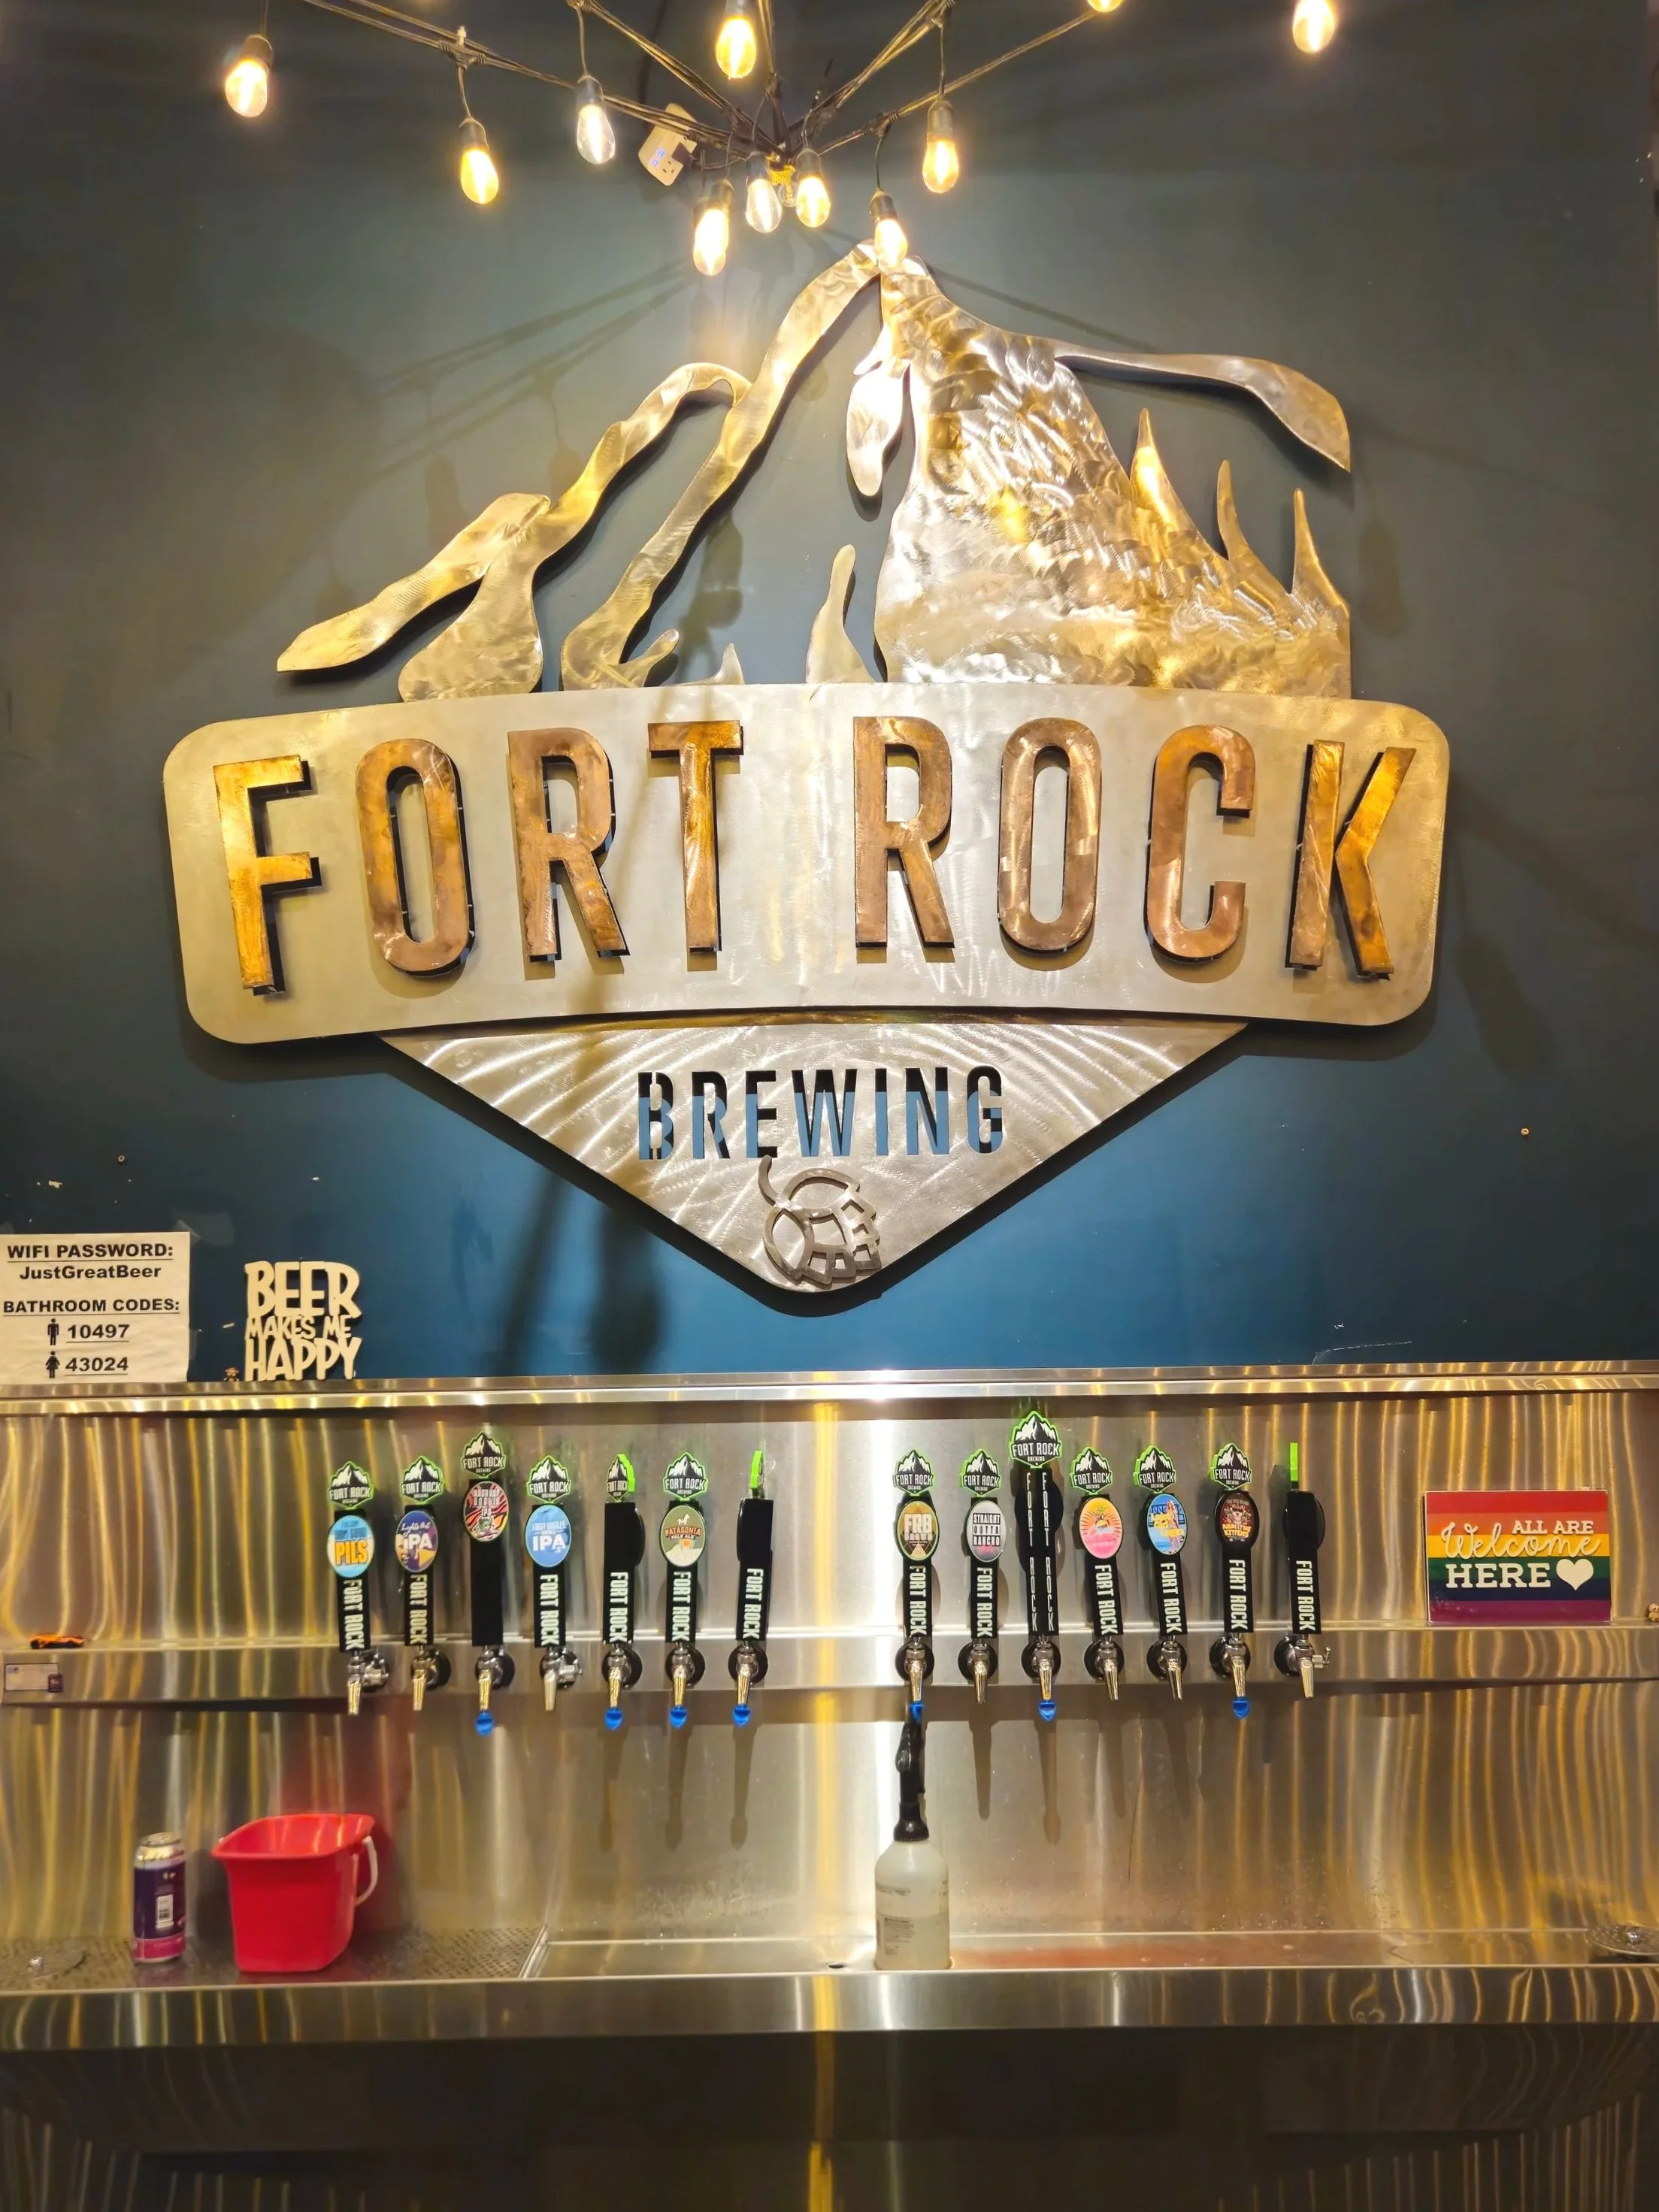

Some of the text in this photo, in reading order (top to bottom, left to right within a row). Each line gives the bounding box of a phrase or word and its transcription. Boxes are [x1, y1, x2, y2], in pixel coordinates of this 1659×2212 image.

[213, 716, 1417, 994] FORT ROCK
[638, 1065, 1003, 1159] BREWING
[8, 1244, 173, 1258] WIFI PASSWORD:
[20, 1265, 161, 1280] JustGreatBeer
[244, 1260, 362, 1318] BEER
[3, 1299, 180, 1313] BATHROOM CODES:
[66, 1324, 130, 1339] 10497
[246, 1315, 352, 1339] MAKES ME
[65, 1357, 129, 1372] 43024
[245, 1337, 362, 1381] HAPPY
[1013, 1442, 1059, 1457] FORT ROCK
[463, 1457, 503, 1469] FORT ROCK
[1215, 1469, 1250, 1481] FORT ROCK
[402, 1481, 441, 1494] FORT ROCK
[529, 1481, 569, 1493] FORT ROCK
[665, 1478, 705, 1490] FORT ROCK
[895, 1474, 932, 1485] FORT ROCK
[964, 1475, 999, 1487] FORT ROCK
[1073, 1473, 1111, 1485] FORT ROCK
[1139, 1472, 1174, 1484] FORT ROCK
[330, 1487, 371, 1500] FORT ROCK
[973, 1514, 1001, 1524] STRAIGHT
[973, 1525, 1000, 1535] OUTTA
[1512, 1521, 1594, 1535] ALL ARE
[404, 1533, 433, 1550] IPA
[532, 1534, 565, 1551] IPA
[665, 1527, 701, 1536] PATAGONIA
[973, 1536, 1001, 1546] RANCHO
[1441, 1521, 1602, 1560] Welcome
[335, 1540, 368, 1565] PILS
[910, 1565, 926, 1597] FORT
[1094, 1564, 1114, 1596] FORT
[1446, 1563, 1552, 1588] HERE
[671, 1571, 691, 1642] FORT ROCK
[743, 1568, 764, 1639] FORT ROCK
[976, 1566, 993, 1637] FORT ROCK
[1029, 1557, 1038, 1632] ROCK
[1046, 1557, 1055, 1632] ROCK
[1160, 1563, 1182, 1634] FORT ROCK
[1229, 1560, 1248, 1630] FORT ROCK
[1296, 1560, 1315, 1631] FORT ROCK
[343, 1579, 365, 1650] FORT ROCK
[410, 1575, 428, 1645] FORT ROCK
[540, 1575, 559, 1645] FORT ROCK
[610, 1572, 628, 1643] FORT ROCK
[910, 1600, 927, 1635] ROCK
[1098, 1599, 1118, 1635] ROCK
